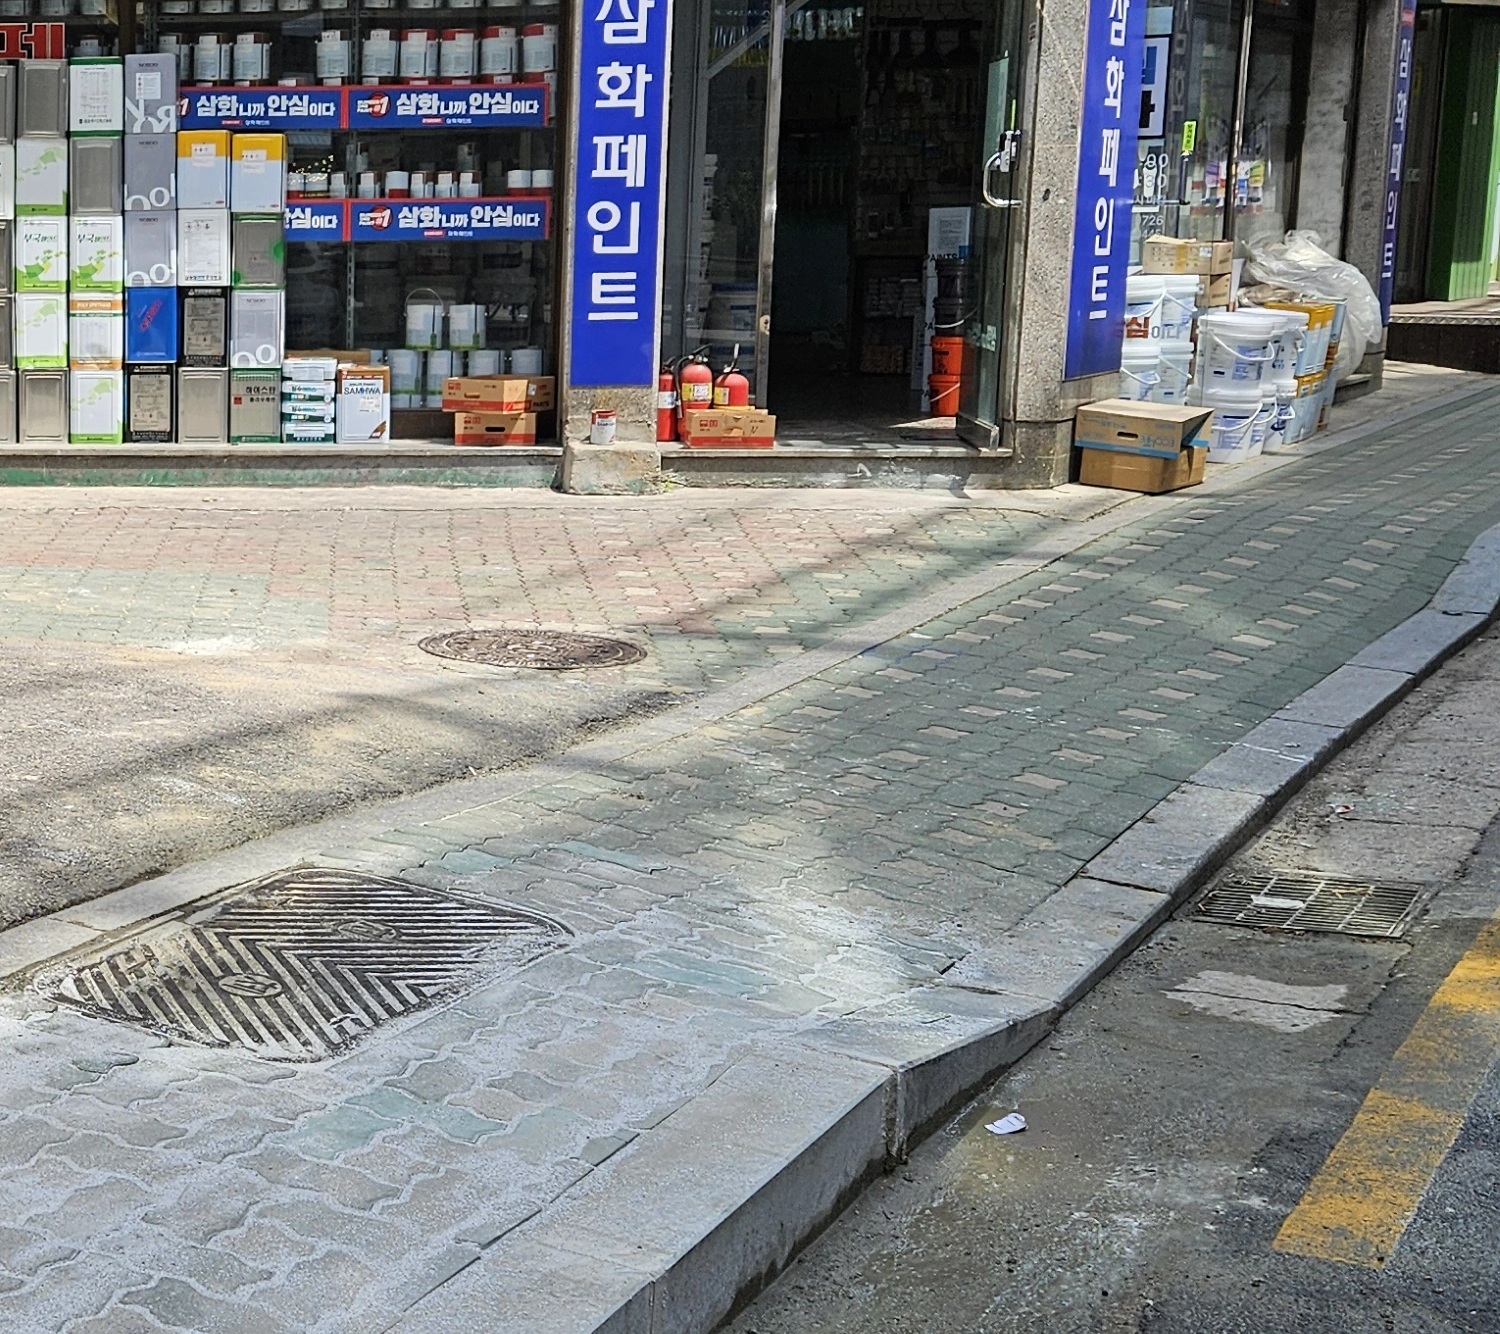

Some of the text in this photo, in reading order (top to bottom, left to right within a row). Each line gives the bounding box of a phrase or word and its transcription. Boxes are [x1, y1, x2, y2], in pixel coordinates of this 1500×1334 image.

[196, 95, 265, 117] 삼화니까
[267, 94, 336, 117] 안심이다
[396, 93, 468, 116] 삼화니까
[469, 92, 540, 115] 안심이다
[397, 206, 469, 229] 삼화니까
[470, 205, 541, 228] 안심이다
[343, 386, 381, 396] SAMHWA
